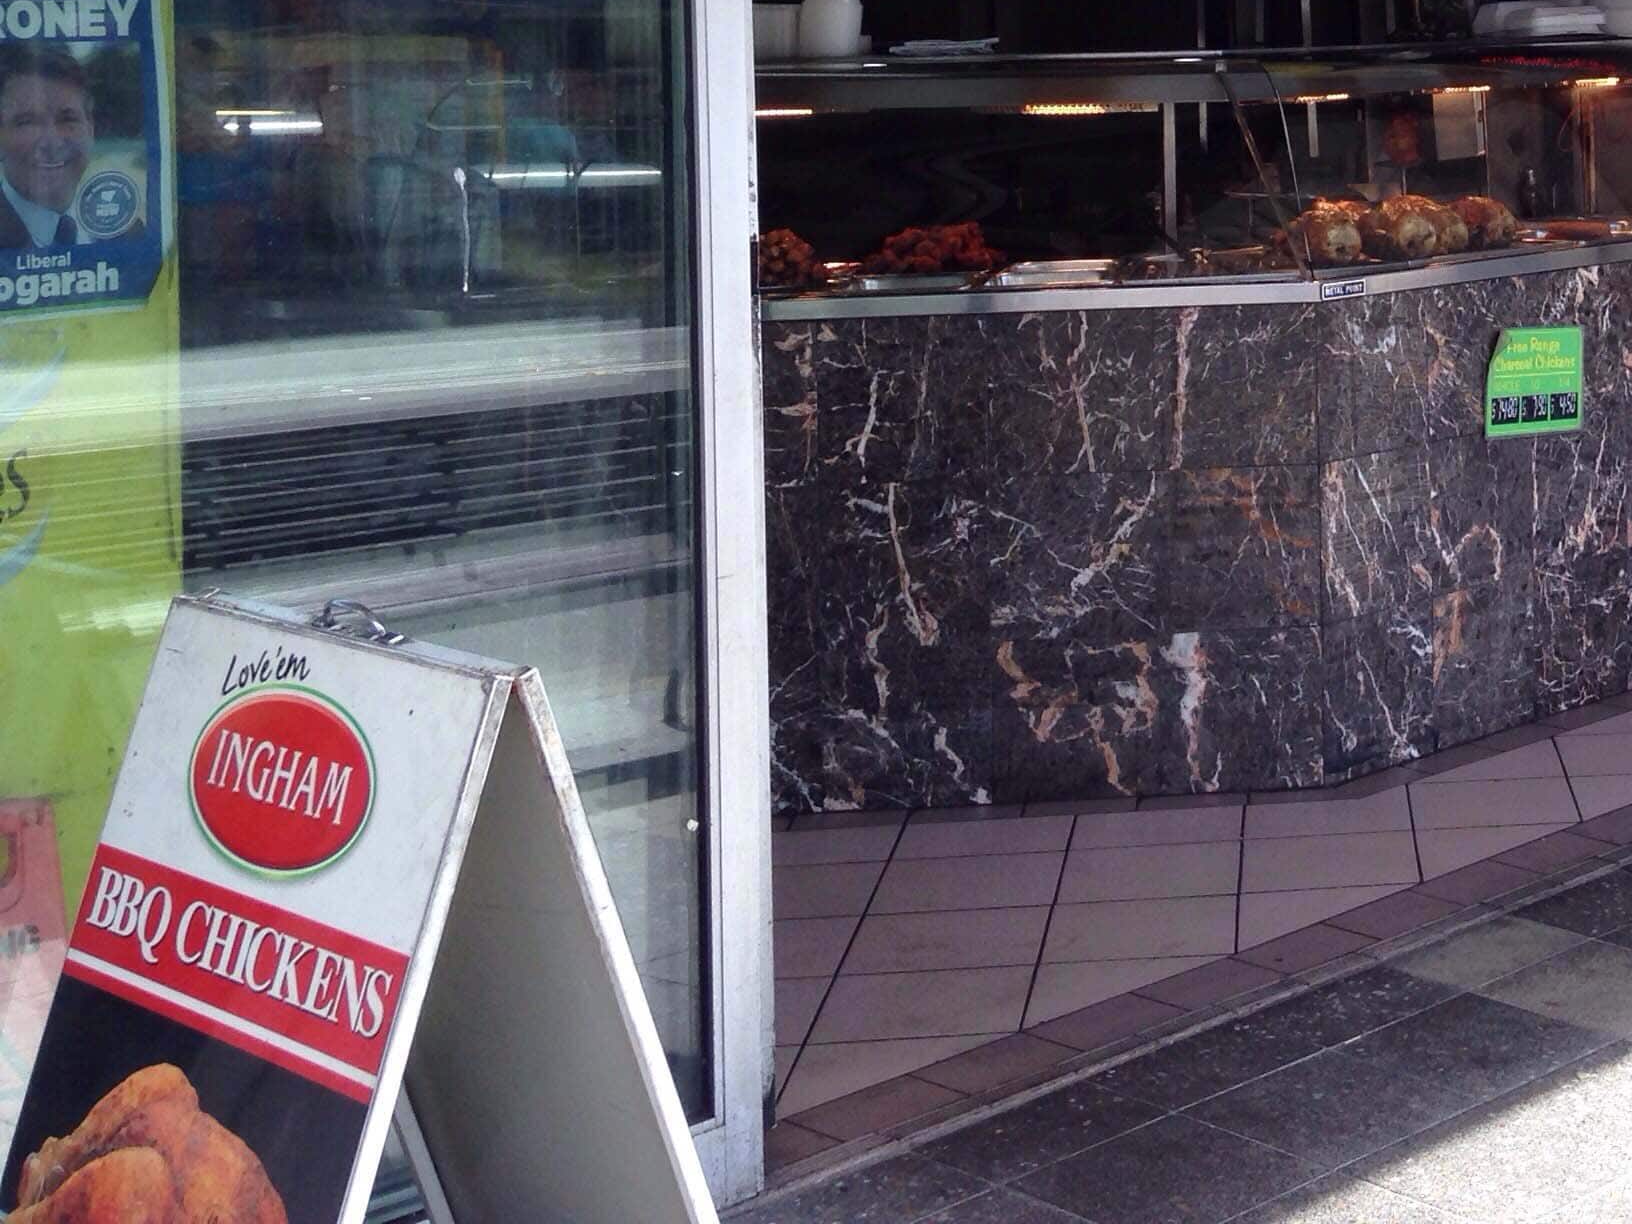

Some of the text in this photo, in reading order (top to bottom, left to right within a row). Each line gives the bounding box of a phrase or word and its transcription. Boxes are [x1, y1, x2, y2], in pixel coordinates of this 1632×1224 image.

[16, 251, 71, 271] Liberal
[1530, 337, 1560, 354] Range
[1535, 354, 1575, 369] Chickens
[206, 727, 354, 826] INGHAM
[85, 865, 395, 1041] BBQ CHICKENS
